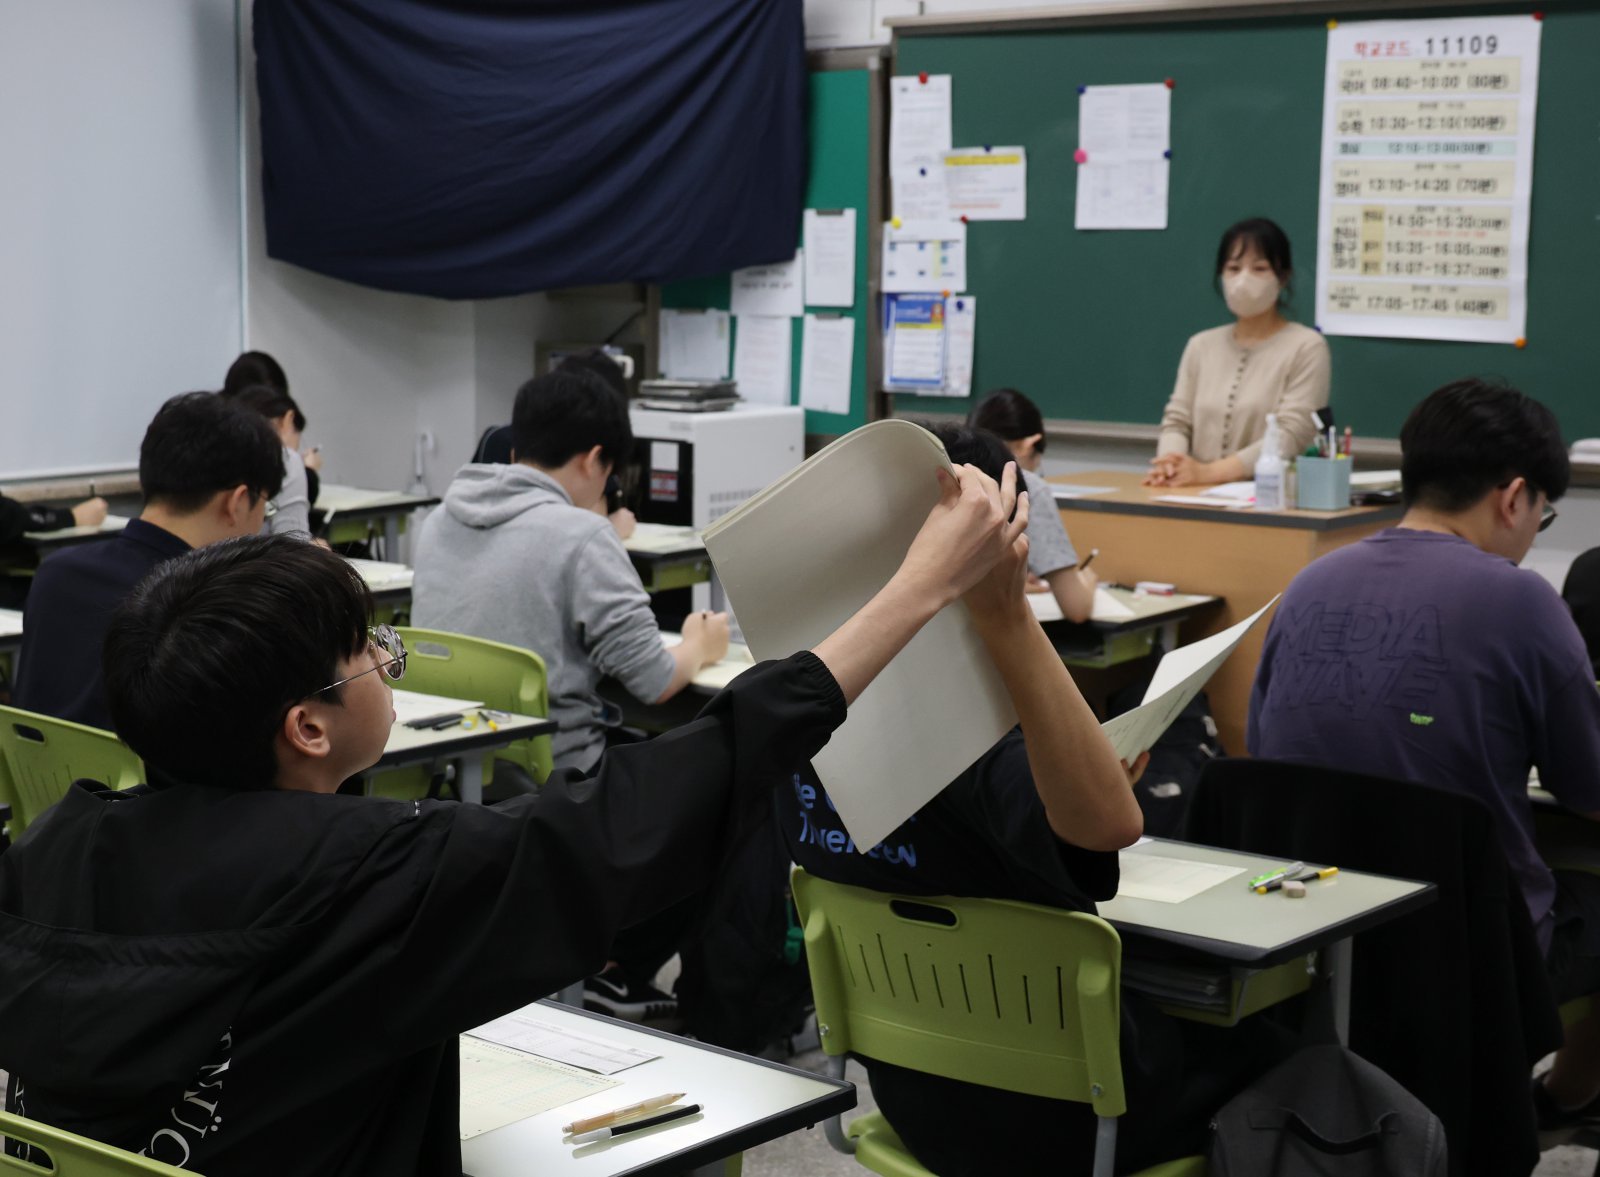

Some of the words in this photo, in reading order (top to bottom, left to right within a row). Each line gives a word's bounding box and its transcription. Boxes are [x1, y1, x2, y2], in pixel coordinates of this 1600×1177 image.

[1425, 34, 1499, 55] 11109
[1277, 601, 1445, 663] MEDIA
[1271, 656, 1450, 720] WAVE
